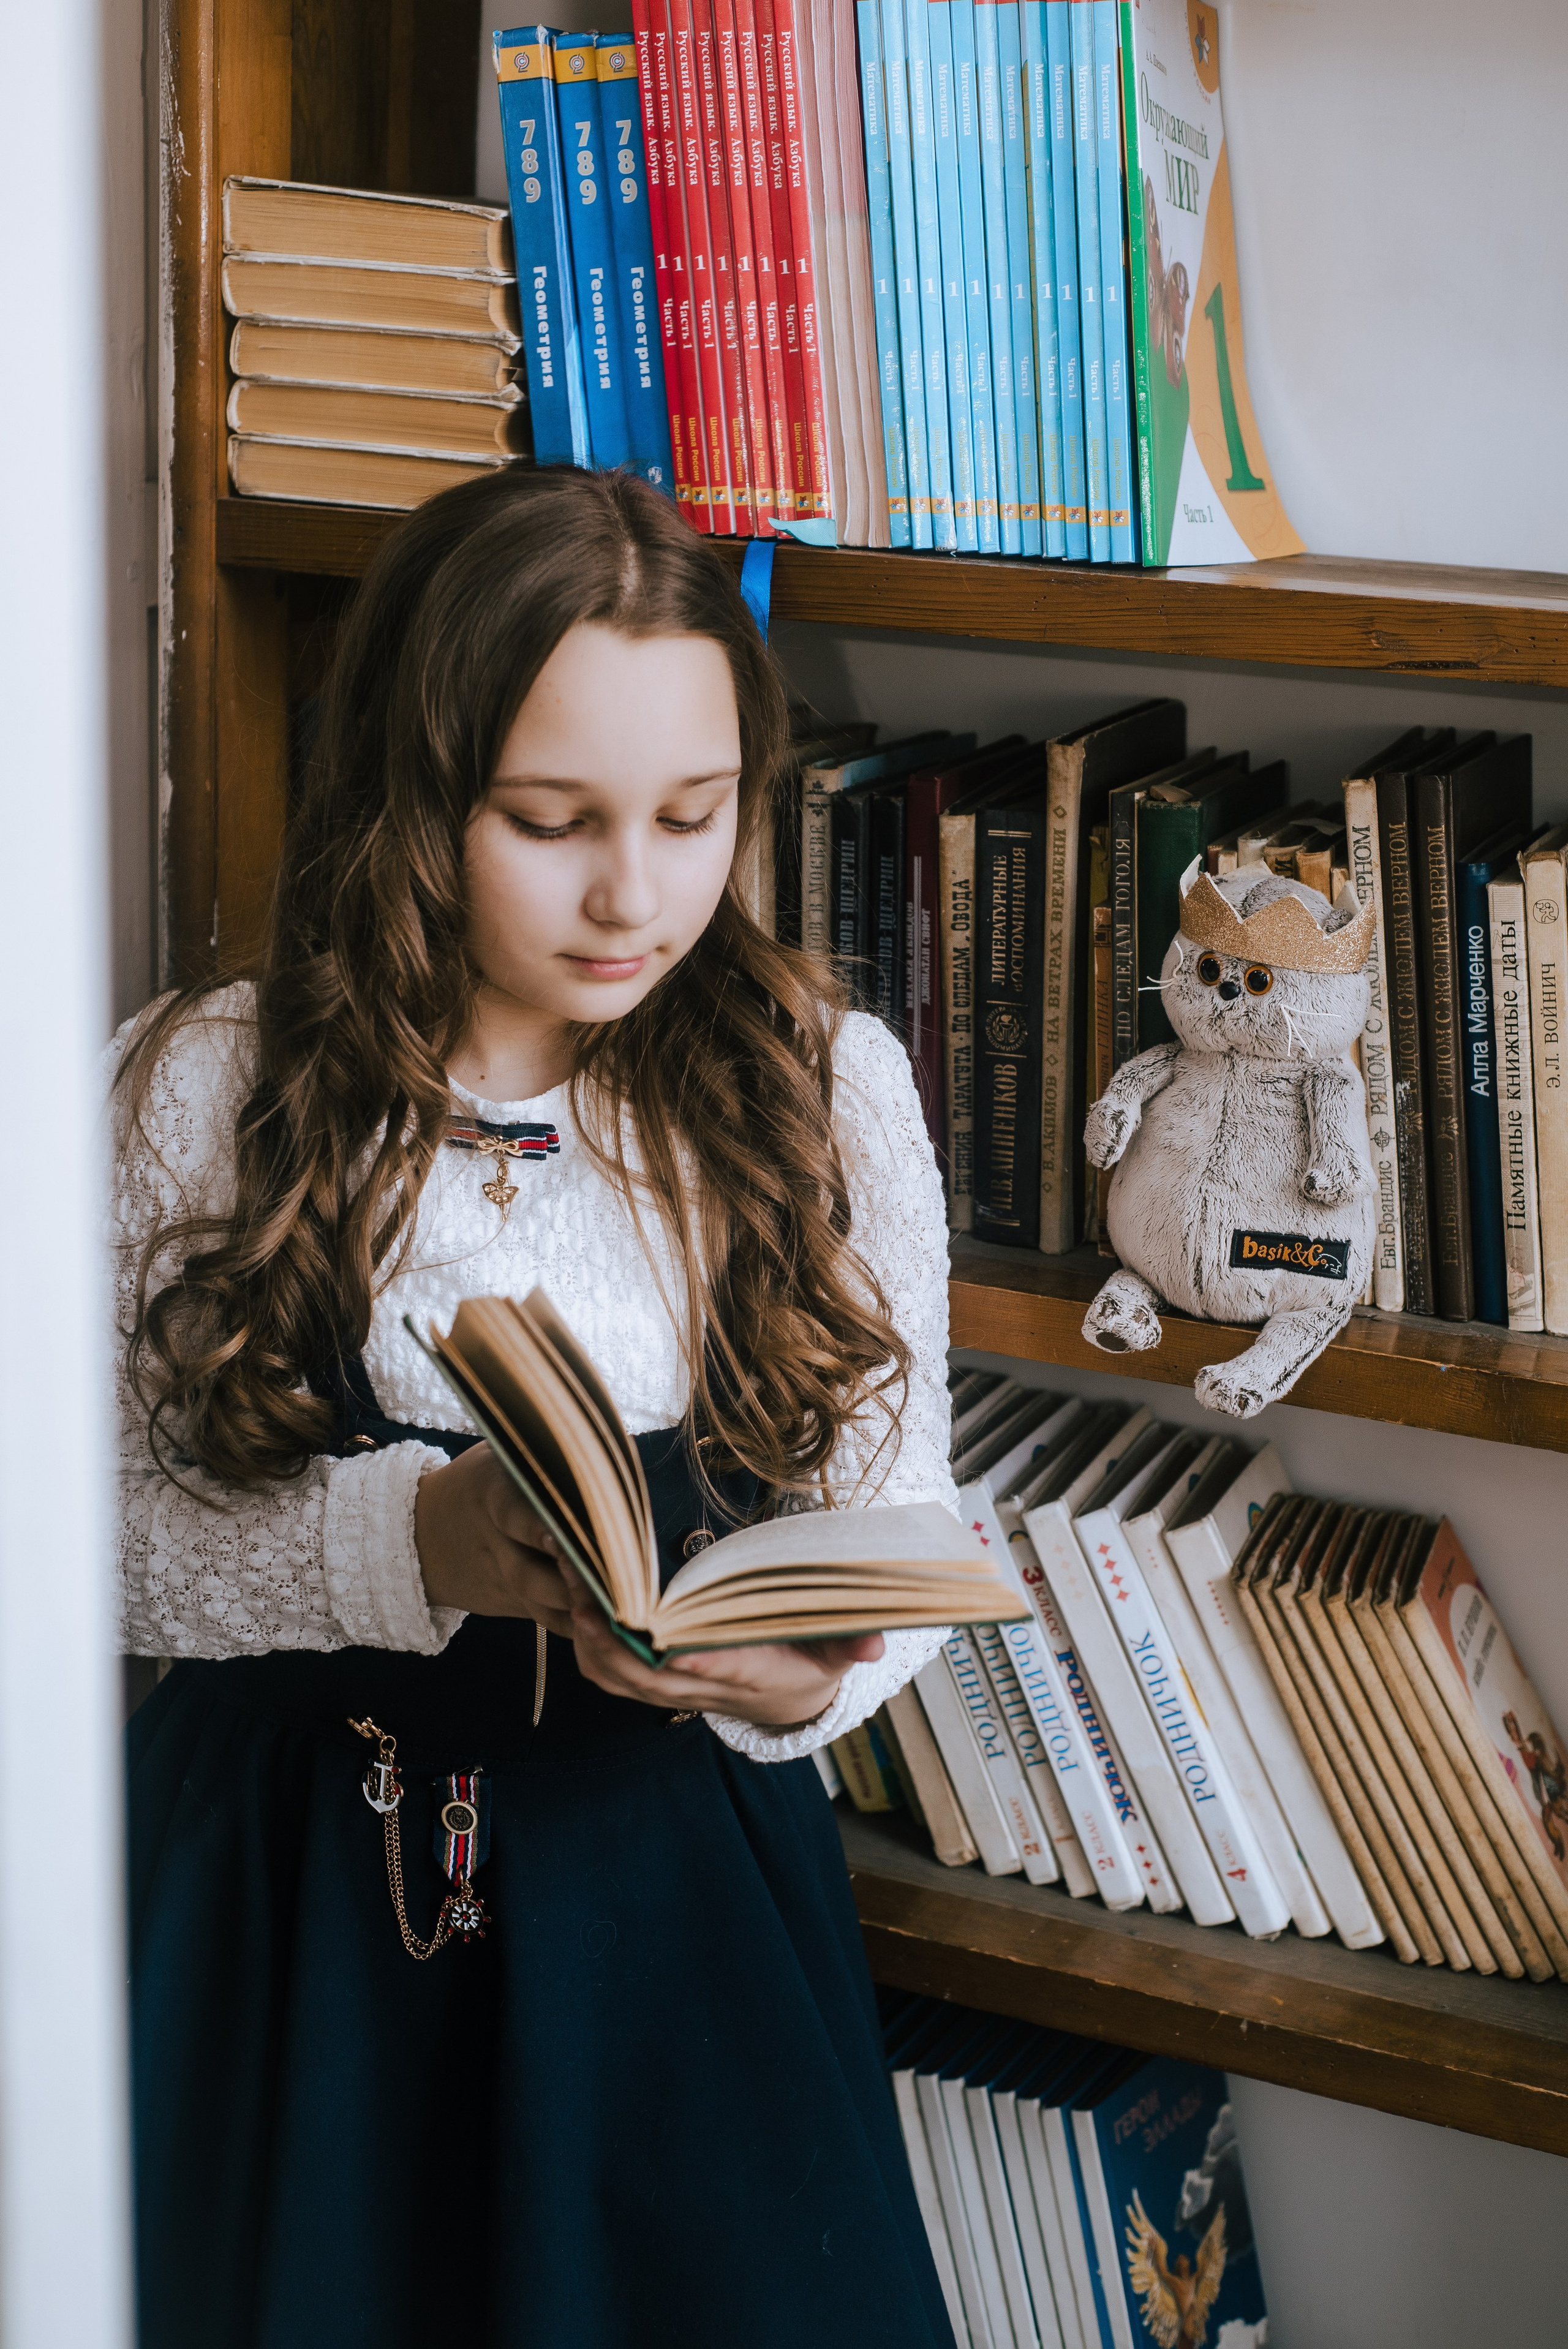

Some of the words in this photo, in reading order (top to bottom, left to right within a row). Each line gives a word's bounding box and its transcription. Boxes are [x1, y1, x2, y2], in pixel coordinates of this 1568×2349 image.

[638, 31, 654, 89] Русский
[654, 32, 669, 90] Русский
[676, 30, 692, 88] Русский
[698, 31, 714, 89] Русский
[720, 31, 736, 89] Русский
[741, 31, 756, 89] Русский
[761, 34, 777, 92] Русский
[780, 31, 795, 90] Русский
[645, 92, 655, 130] язык.
[661, 94, 670, 132] язык.
[683, 92, 693, 130] язык.
[705, 93, 715, 131] язык.
[728, 92, 737, 131] язык.
[748, 94, 758, 132] язык.
[768, 96, 778, 134] язык.
[786, 94, 796, 132] язык.
[867, 62, 878, 135] Математика
[892, 60, 902, 134] Математика
[915, 60, 925, 134] Математика
[938, 64, 948, 137] Математика
[960, 62, 971, 136] Математика
[984, 66, 993, 140] Математика
[1006, 65, 1016, 139] Математика
[1035, 64, 1044, 138] Математика
[1055, 64, 1065, 139] Математика
[1079, 66, 1088, 140] Математика
[1101, 64, 1110, 139] Математика
[1140, 71, 1209, 160] Окружающий
[648, 137, 660, 184] Азбука
[664, 138, 676, 186] Азбука
[686, 137, 698, 185] Азбука
[709, 138, 721, 186] Азбука
[731, 138, 744, 186] Азбука
[751, 138, 763, 186] Азбука
[771, 141, 783, 189] Азбука
[790, 139, 802, 187] Азбука
[1164, 149, 1198, 215] МИР
[657, 254, 668, 269] 1
[673, 256, 684, 271] 1
[695, 254, 706, 270] 1
[717, 255, 728, 271] 1
[740, 256, 751, 271] 1
[760, 257, 771, 272] 1
[779, 259, 790, 274] 1
[797, 258, 809, 273] 1
[878, 279, 888, 293] 1
[903, 277, 913, 293] 1
[925, 277, 936, 293] 1
[948, 281, 959, 296] 1
[970, 279, 981, 295] 1
[663, 298, 673, 337] Часть
[701, 299, 711, 338] Часть
[993, 284, 1003, 299] 1
[1014, 284, 1025, 299] 1
[1042, 283, 1053, 298] 1
[1061, 284, 1072, 300] 1
[1085, 287, 1095, 302] 1
[1107, 285, 1118, 301] 1
[533, 266, 554, 388] Геометрия
[589, 267, 611, 390] Геометрия
[630, 266, 652, 388] Геометрия
[679, 300, 689, 339] Часть
[747, 300, 757, 340] Часть
[786, 304, 795, 344] Часть
[1090, 360, 1099, 393] Часть
[1204, 282, 1266, 492] 1
[1183, 505, 1206, 522] Часть
[1207, 506, 1214, 522] 1
[809, 824, 826, 895] МОСКВЕ
[1050, 828, 1066, 923] ВРЕМЕНИ
[1115, 838, 1131, 911] ГОГОЛЯ
[1389, 821, 1411, 906] ВЕРНОМ
[1427, 824, 1449, 910] ВЕРНОМ
[921, 908, 931, 945] СВИФТ
[991, 854, 1007, 986] ЛИТЕРАТУРНЫЕ
[1010, 846, 1027, 992] ВОСПОМИНАНИЯ
[921, 948, 931, 1005] ДЖОНАТАН
[952, 947, 971, 1008] СЛЕДАМ
[1047, 928, 1063, 1009] ВЕТРАХ
[1115, 923, 1134, 1003] СЛЕДАМ
[1395, 912, 1415, 1000] ЖЮЛЕМ
[1431, 916, 1452, 1005] ЖЮЛЕМ
[1501, 919, 1521, 981] даты
[1468, 925, 1488, 1033] Марченко
[1540, 962, 1559, 1045] ВОЙНИЧ
[951, 1014, 971, 1033] ПО
[1046, 1016, 1060, 1044] НА
[1116, 1011, 1131, 1038] ПО
[1365, 1018, 1382, 1034] С
[1398, 1006, 1414, 1019] С
[1434, 1010, 1452, 1024] С
[1434, 1028, 1455, 1098] РЯДОМ
[1470, 1039, 1490, 1096] Алла
[1502, 990, 1523, 1101] книжные
[953, 1046, 973, 1119] ТАРАТУТА
[1366, 1043, 1389, 1117] РЯДОМ
[1506, 1110, 1526, 1232] Памятные
[948, 1629, 1006, 1758] РОДНИЧ
[976, 1623, 1046, 1768] РОДНИЧО
[1004, 1623, 1078, 1772] РОДНИЧО
[1022, 1566, 1042, 1585] 3
[1054, 1646, 1138, 1827] РОДНИЧОК
[1129, 1629, 1216, 1803] РОДНИЧОК
[1226, 1868, 1248, 1882] 4
